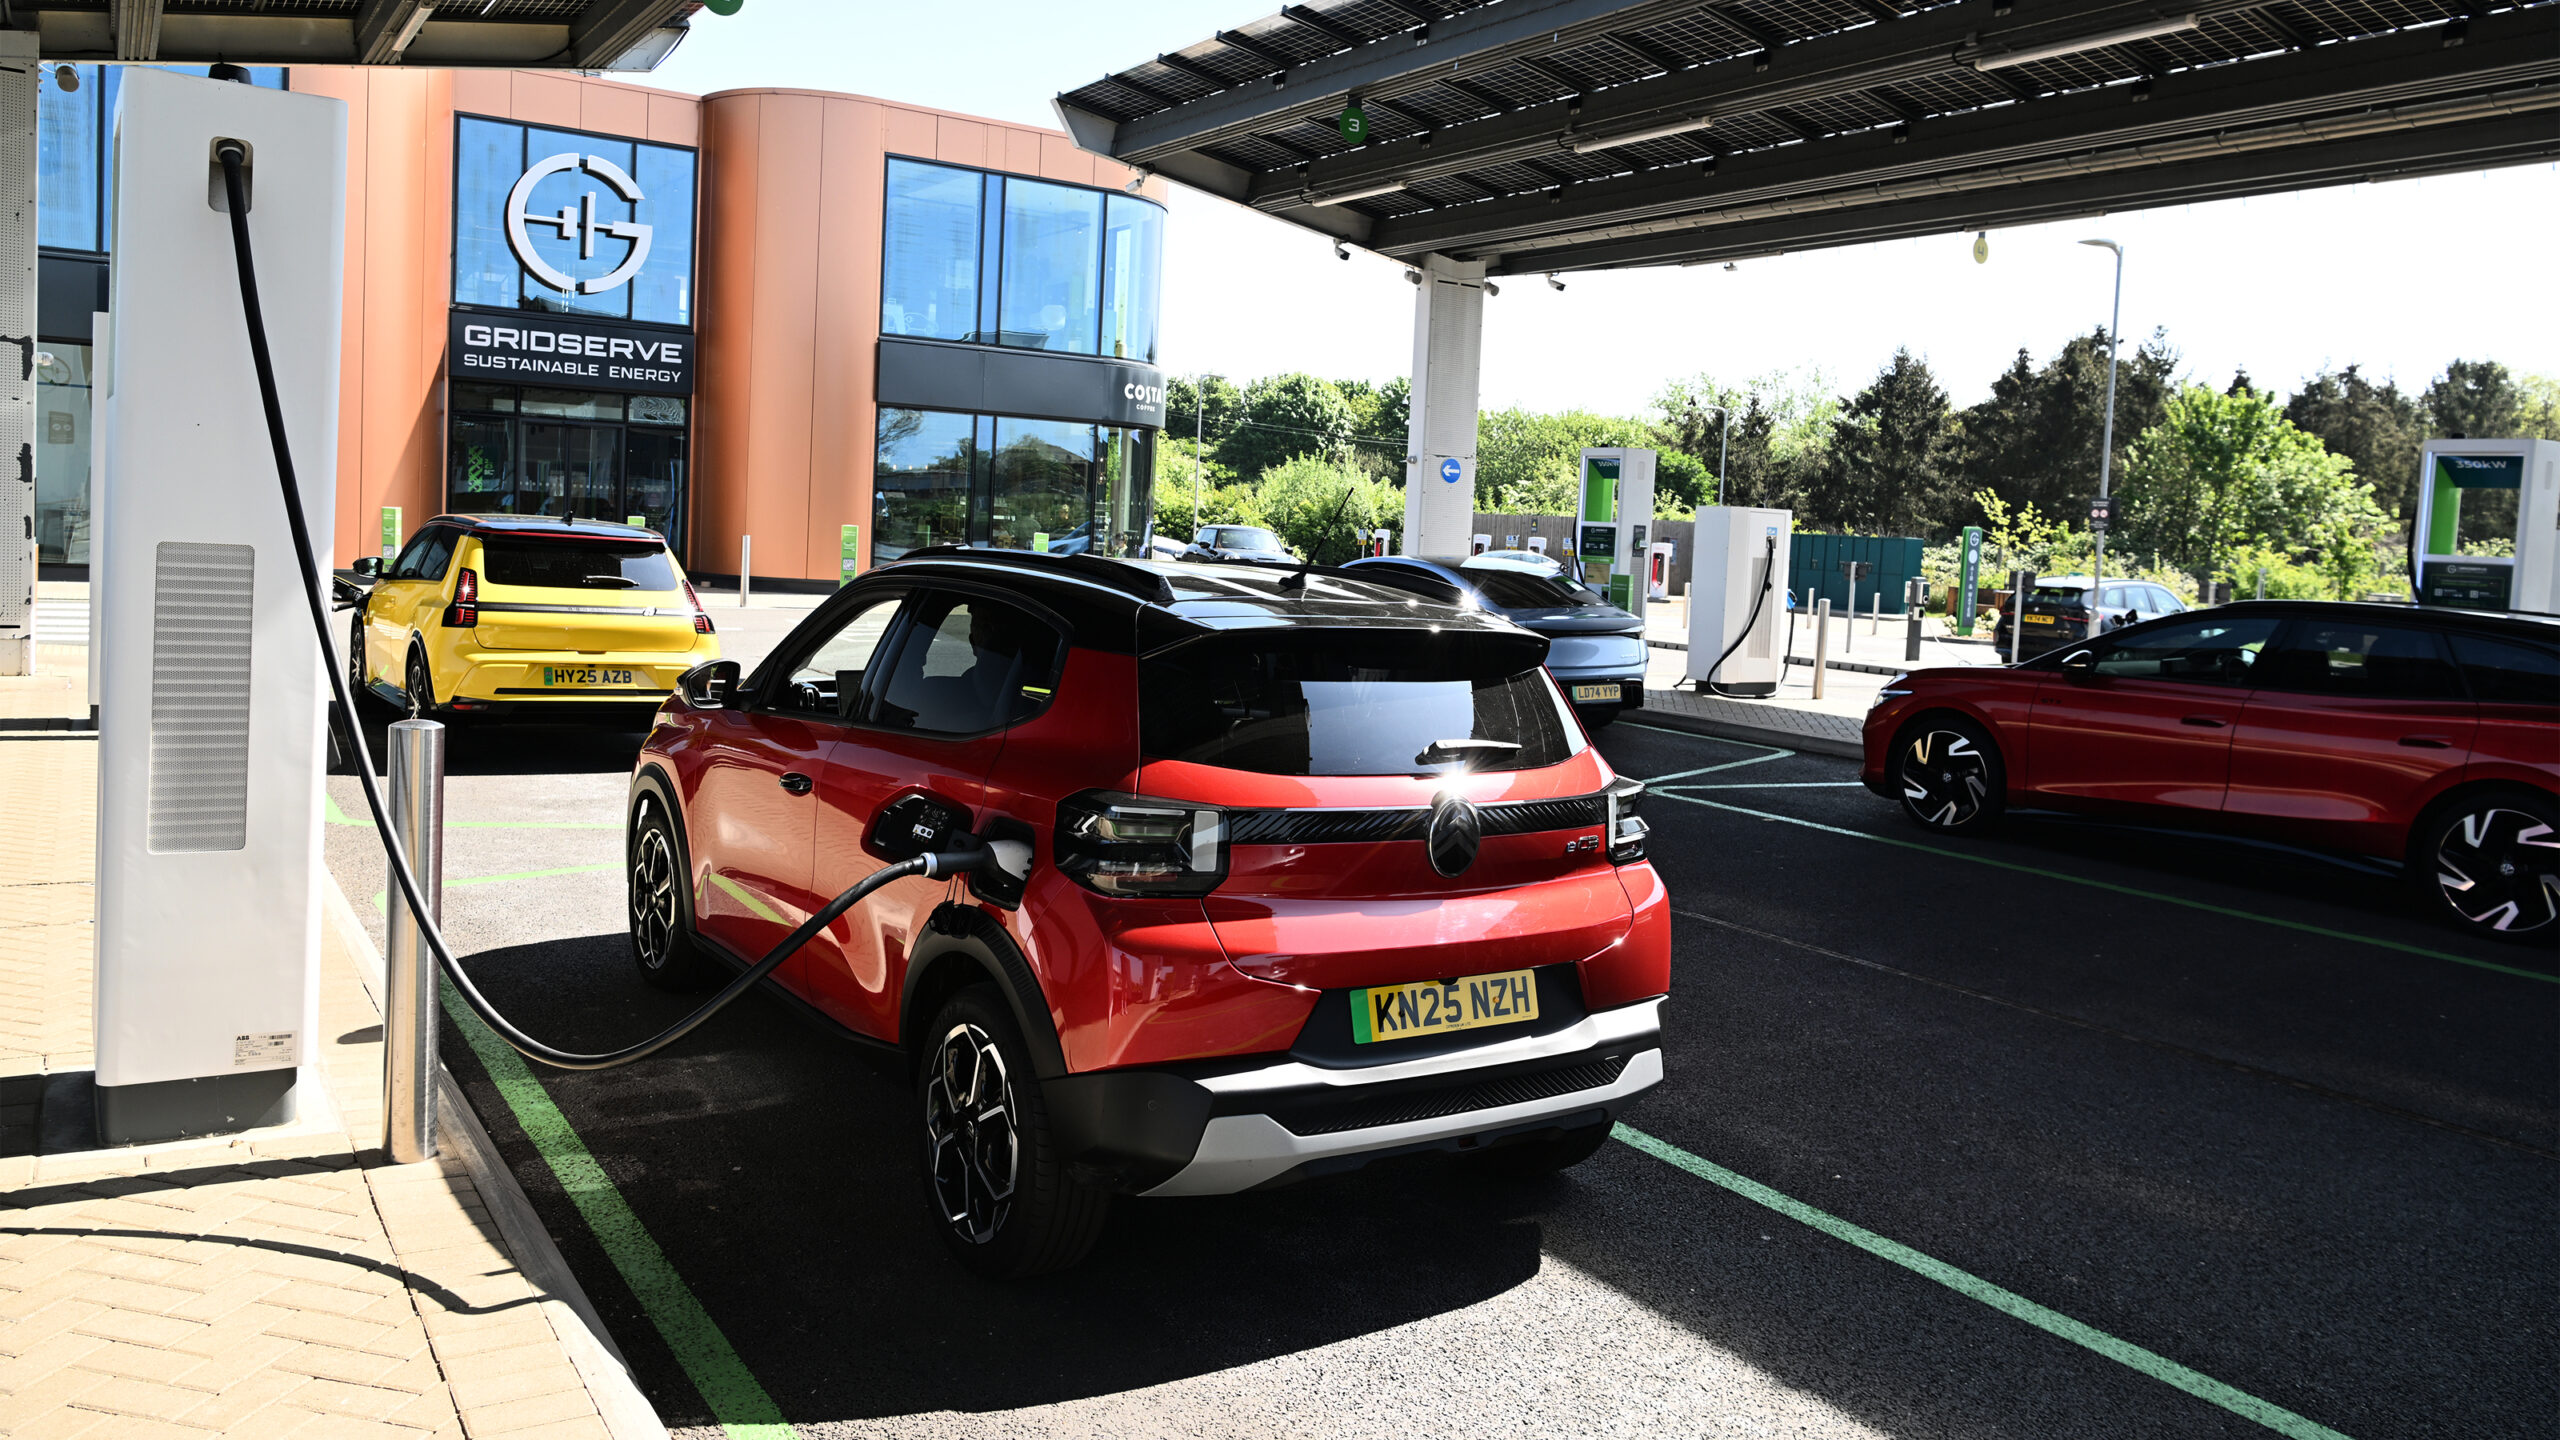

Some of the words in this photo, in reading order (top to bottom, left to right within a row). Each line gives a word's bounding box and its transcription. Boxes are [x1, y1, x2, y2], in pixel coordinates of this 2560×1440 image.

[1349, 118, 1360, 132] 3
[464, 324, 683, 364] GRIDSERVE
[463, 353, 600, 377] SUSTAINABLE
[608, 366, 682, 383] ENERGY
[1124, 382, 1162, 405] COSTA
[1136, 404, 1156, 412] COFFEE
[2455, 460, 2507, 469] 350kW
[554, 669, 597, 683] HY25
[602, 670, 632, 684] AZB
[1578, 687, 1601, 698] LD74
[1602, 686, 1619, 697] YYP
[1375, 984, 1463, 1033] KN25
[1470, 976, 1531, 1020] NZH
